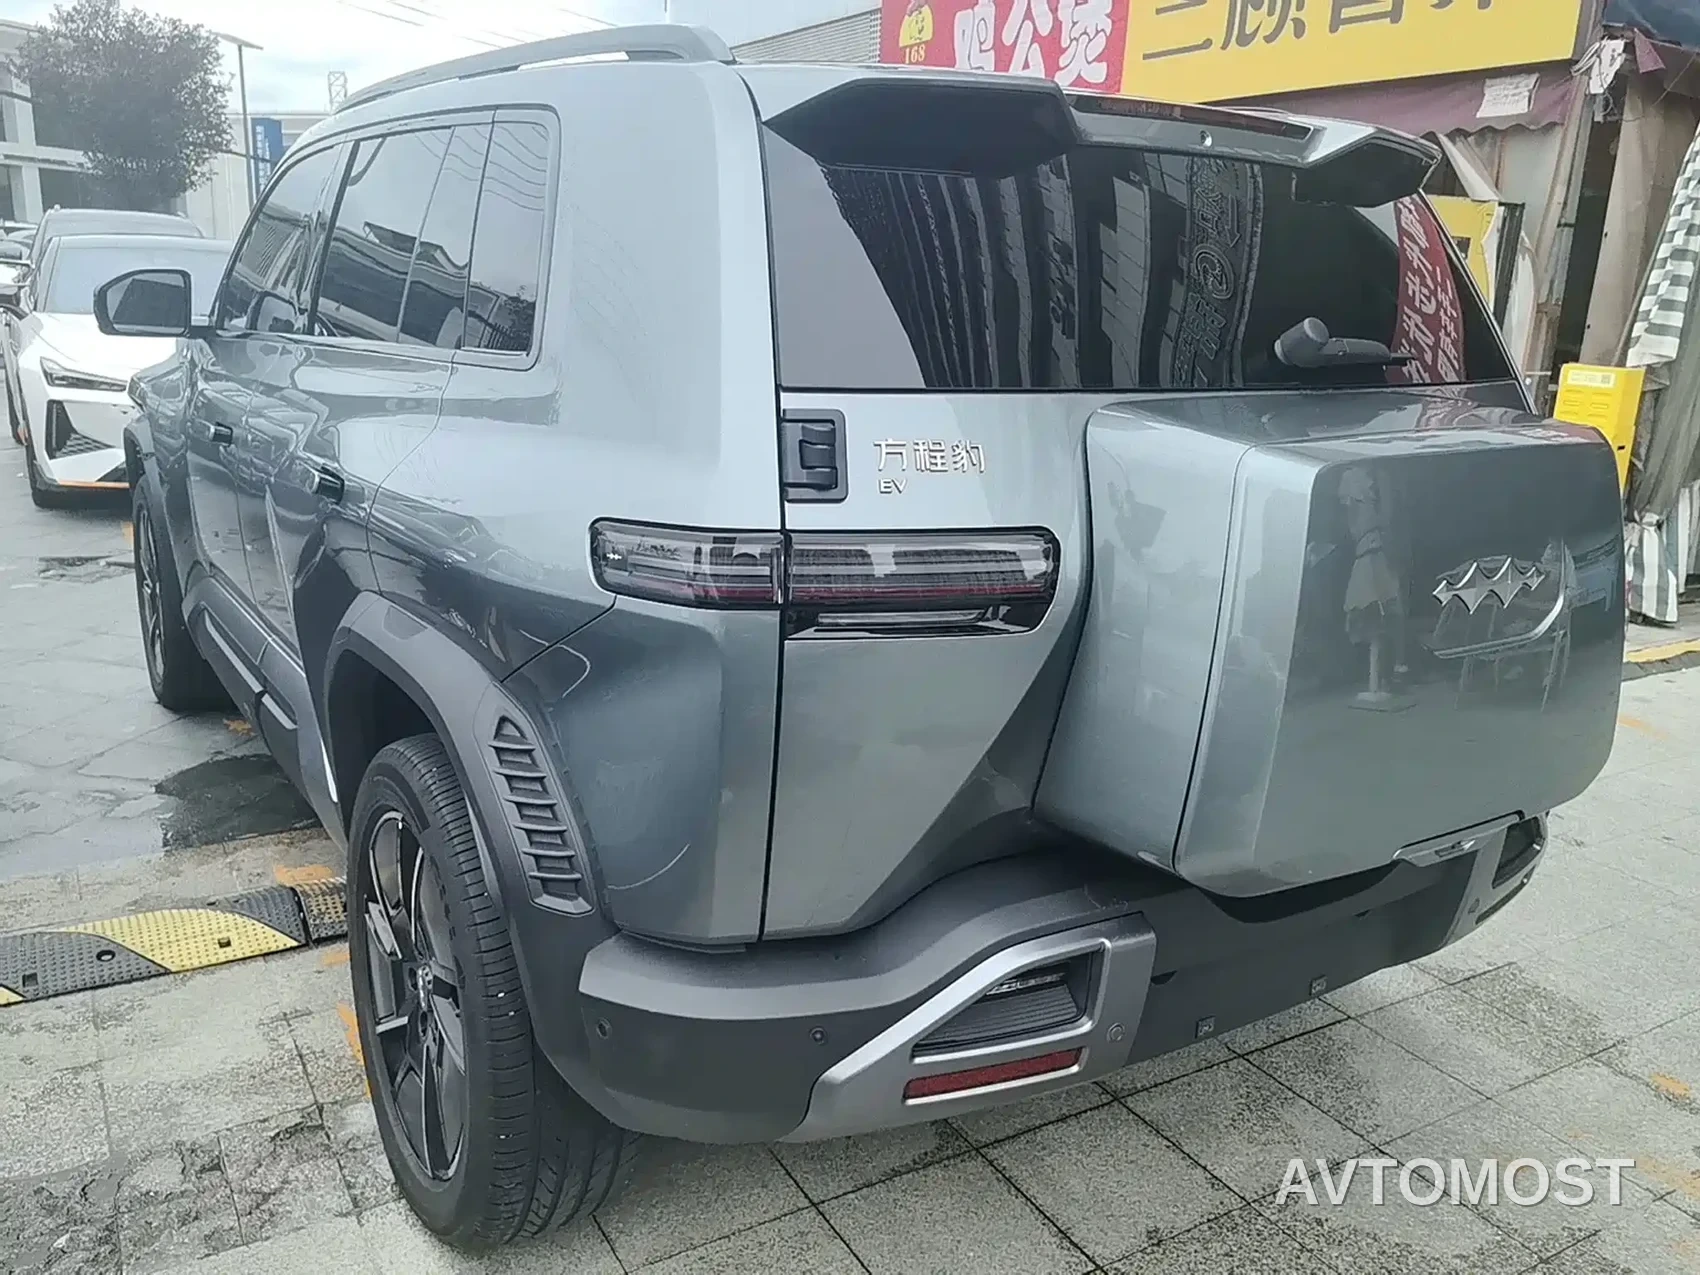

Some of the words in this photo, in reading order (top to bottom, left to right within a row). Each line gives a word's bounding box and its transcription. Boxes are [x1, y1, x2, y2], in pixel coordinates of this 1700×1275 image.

[904, 45, 926, 65] 168
[873, 438, 985, 473] 方程豹
[878, 479, 907, 493] EV
